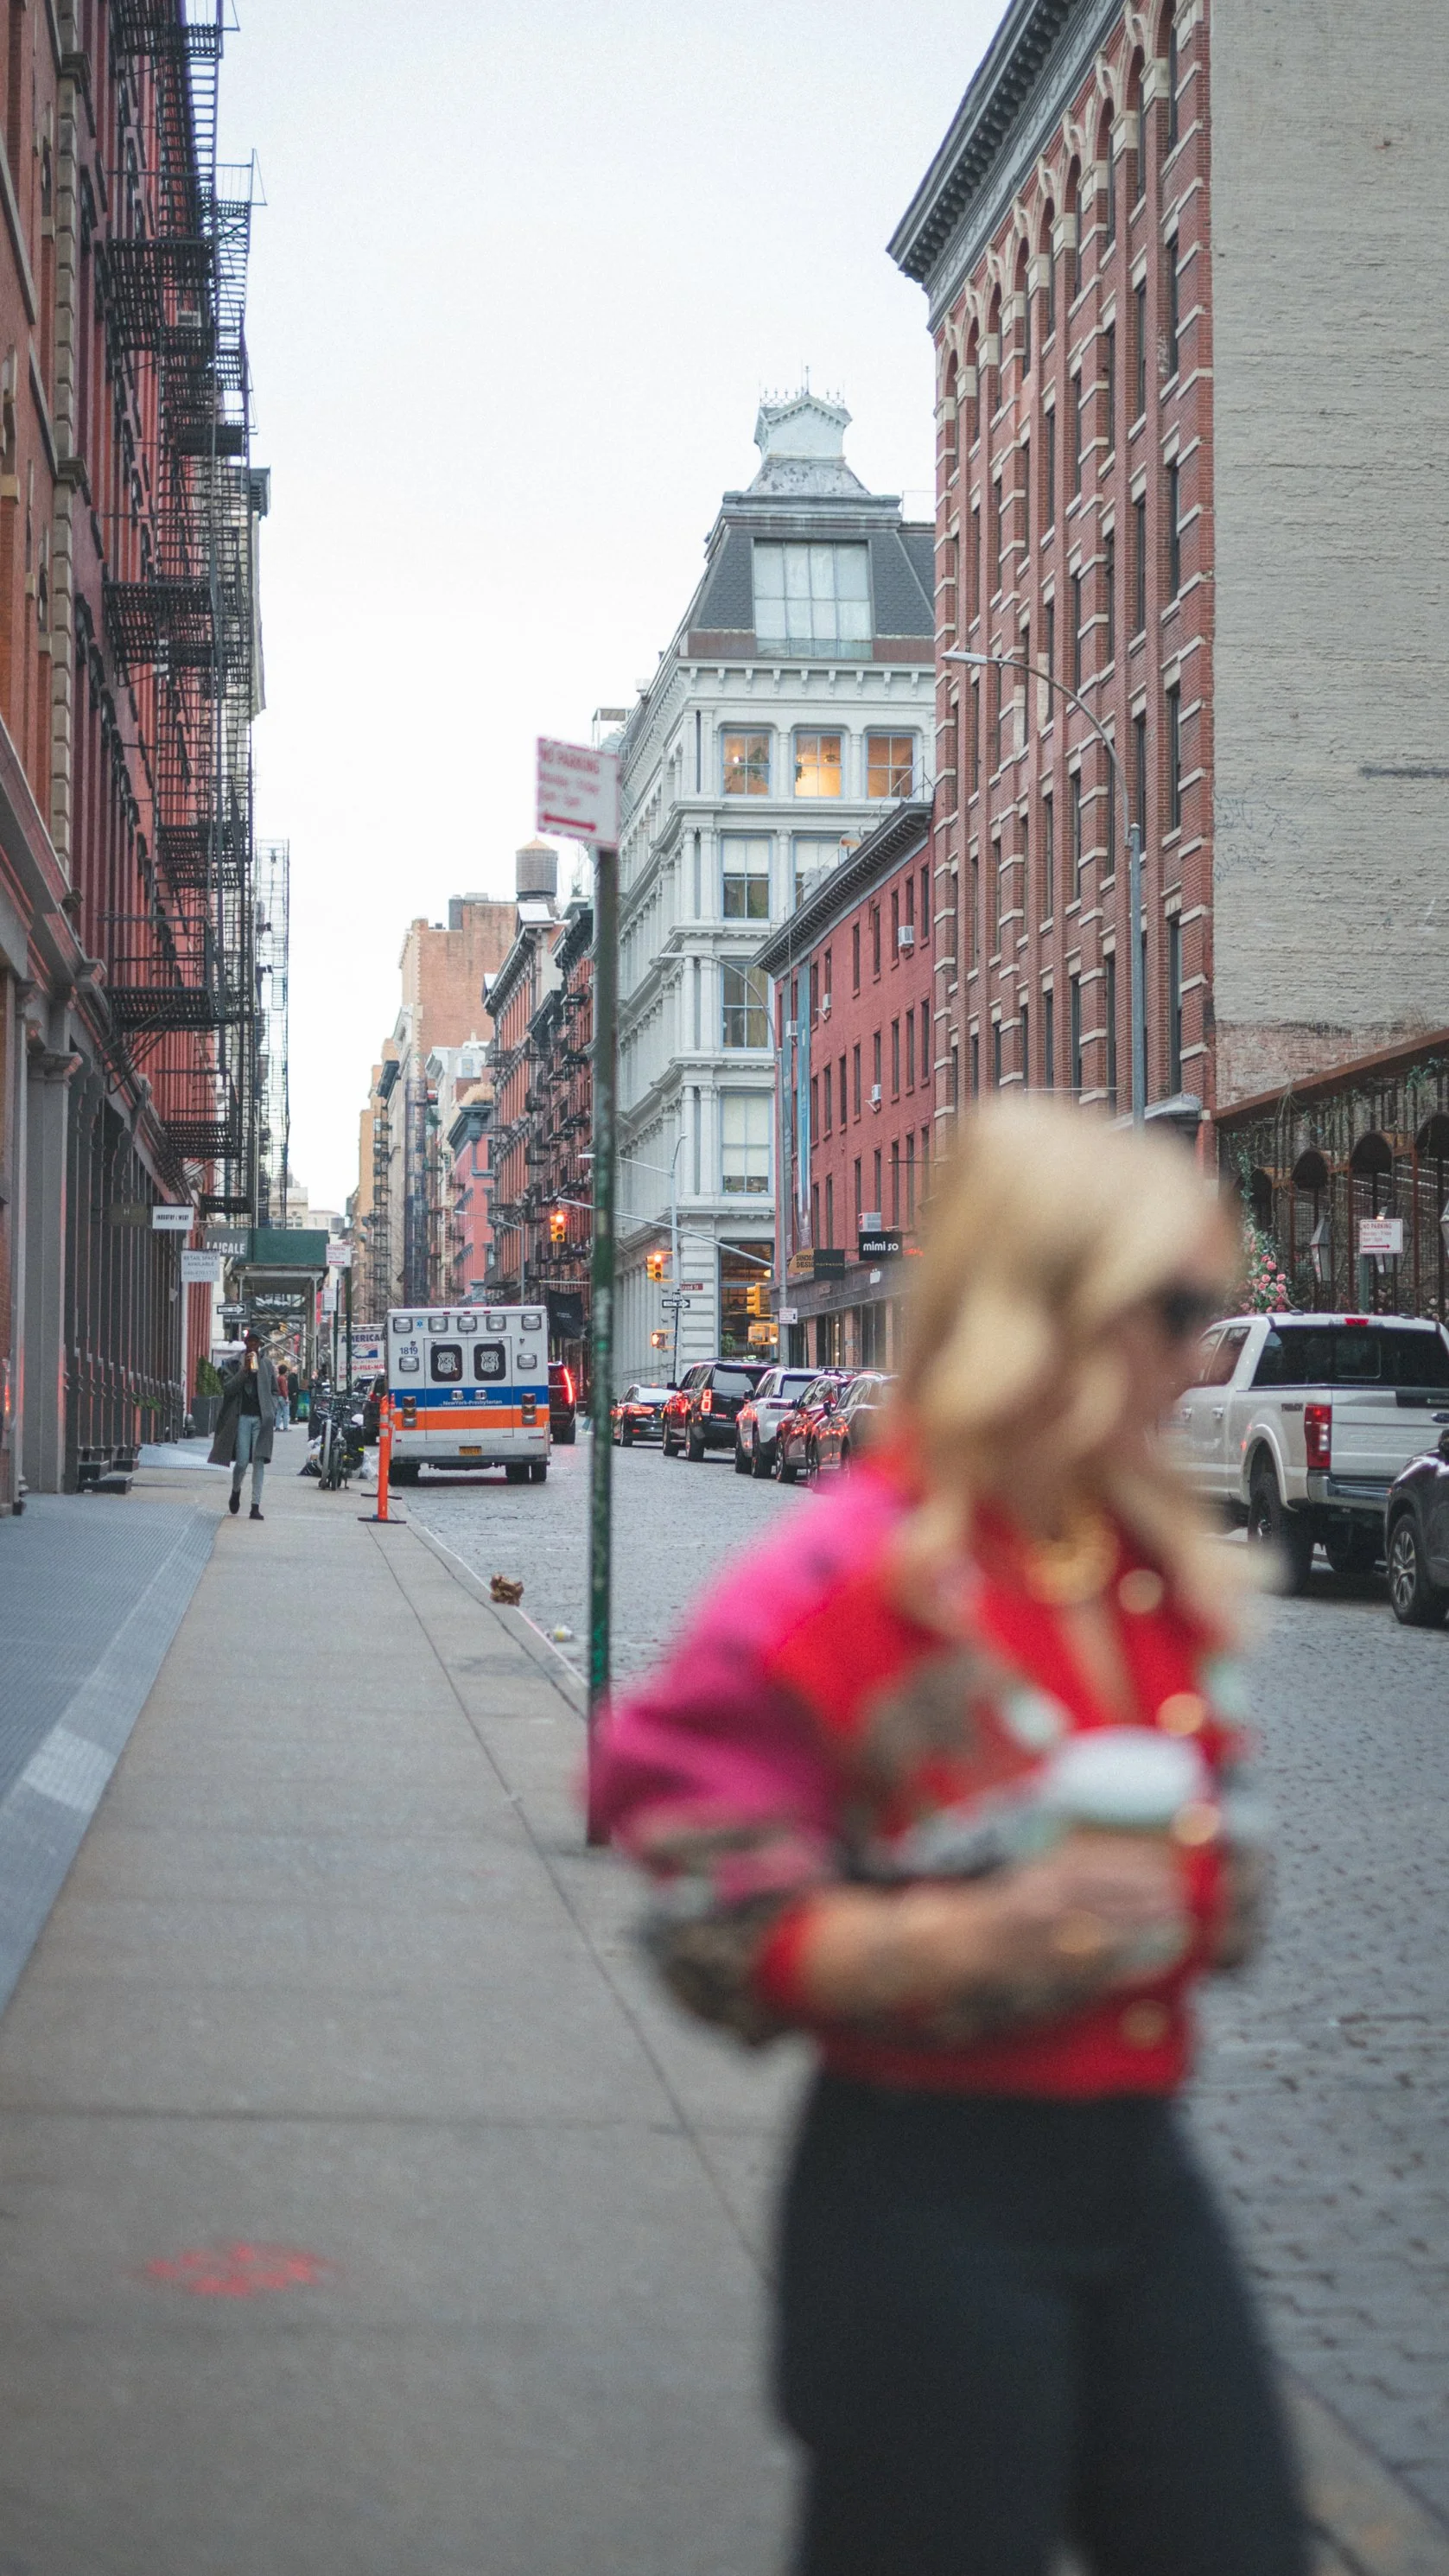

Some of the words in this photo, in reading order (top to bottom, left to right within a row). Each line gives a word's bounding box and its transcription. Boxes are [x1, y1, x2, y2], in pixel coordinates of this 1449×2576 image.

[556, 750, 601, 774] PARKING
[863, 1241, 886, 1251] mimi
[887, 1243, 899, 1251] so
